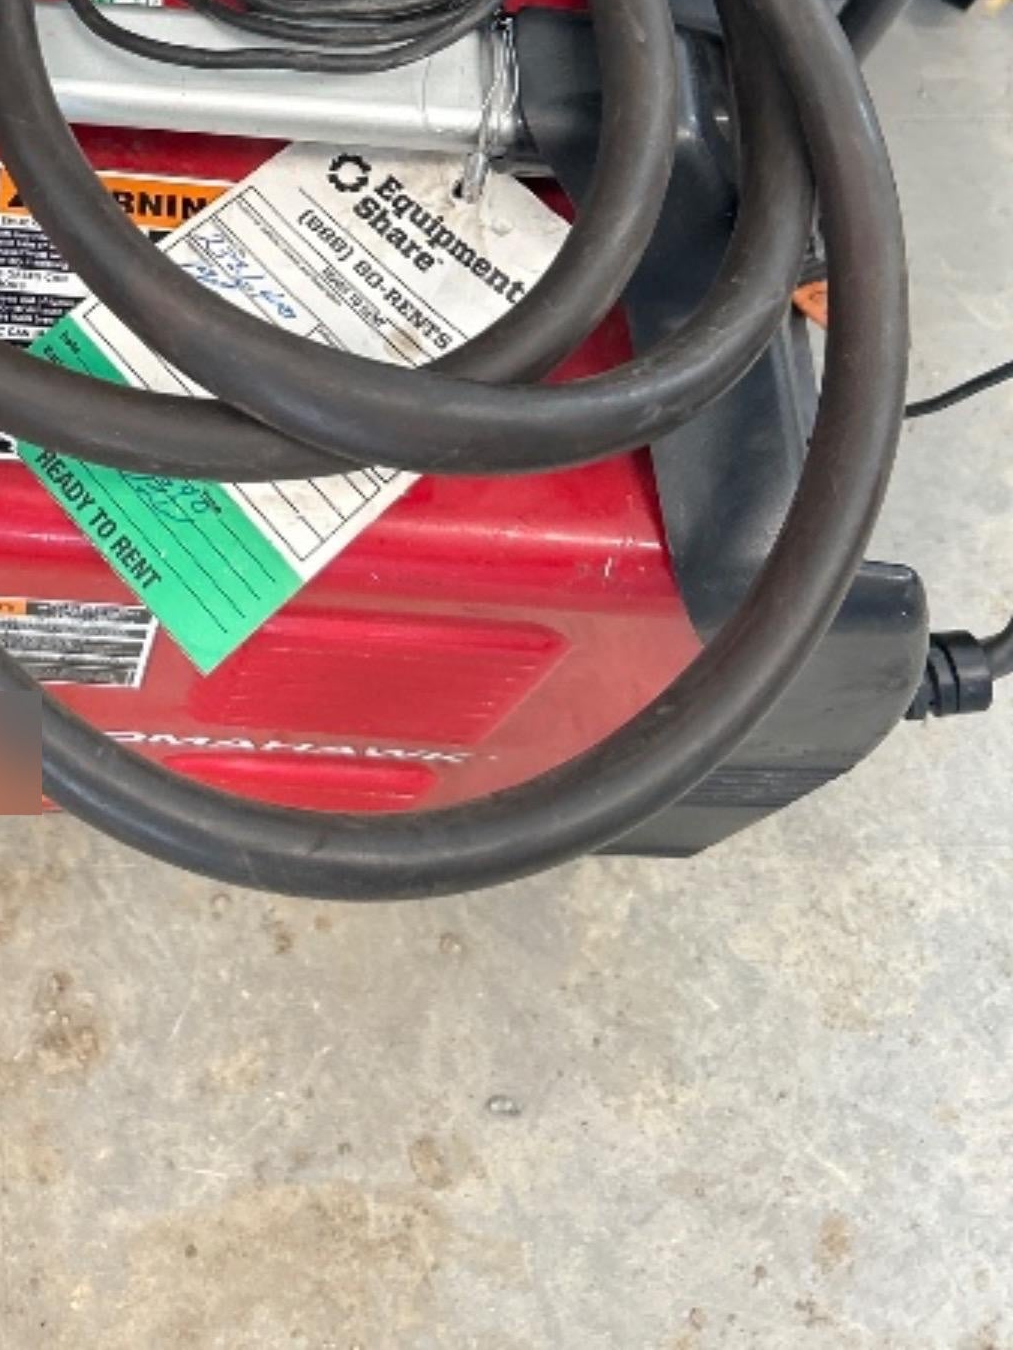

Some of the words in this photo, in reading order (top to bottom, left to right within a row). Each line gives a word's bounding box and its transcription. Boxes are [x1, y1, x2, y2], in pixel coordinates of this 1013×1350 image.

[353, 197, 435, 272] Share
[374, 174, 526, 304] Equipment
[353, 260, 452, 350] 80-RENTS
[38, 450, 95, 511] READY
[89, 507, 116, 539] TO
[111, 535, 162, 588] RENT
